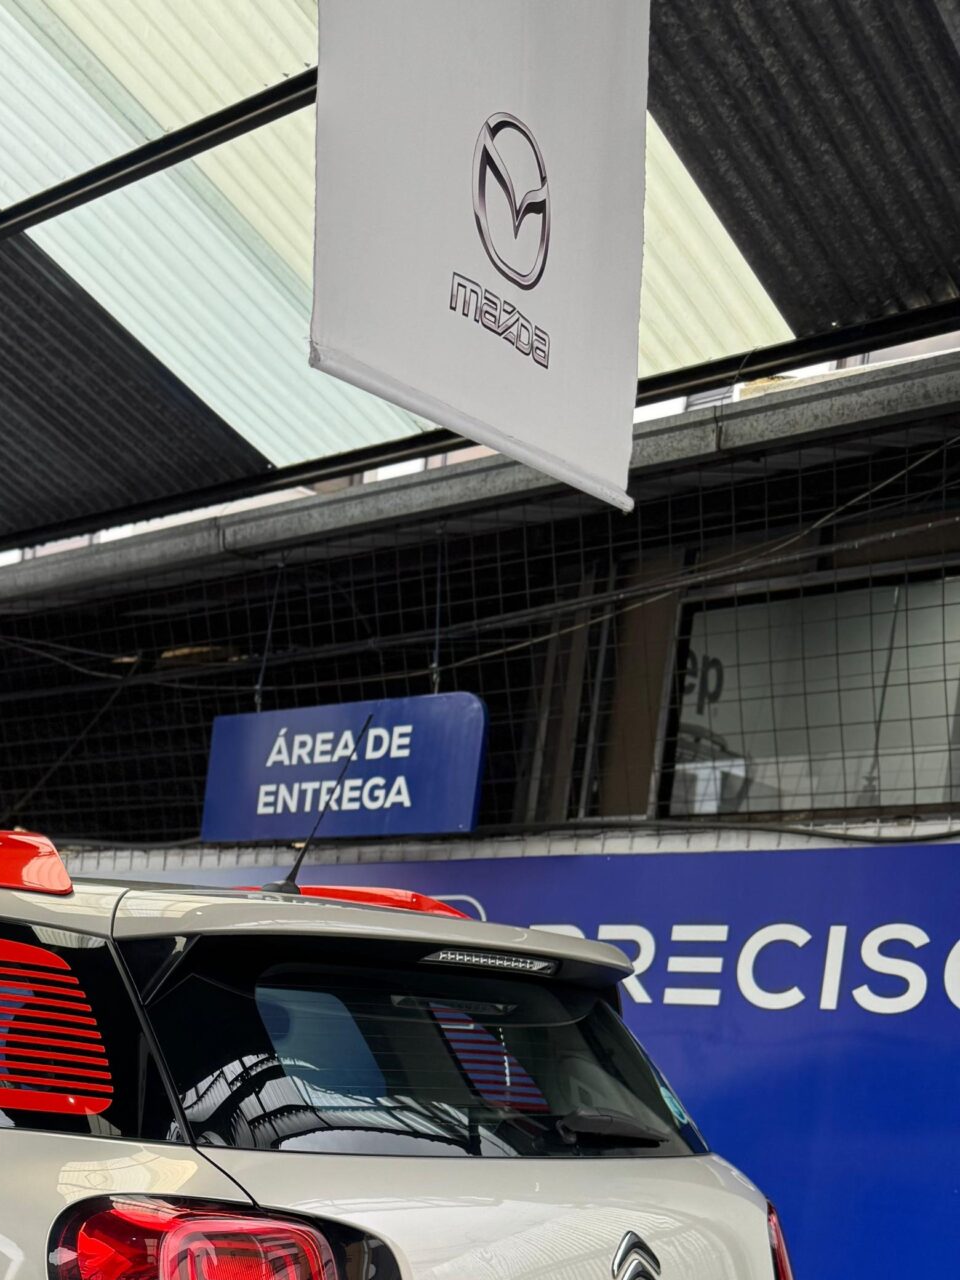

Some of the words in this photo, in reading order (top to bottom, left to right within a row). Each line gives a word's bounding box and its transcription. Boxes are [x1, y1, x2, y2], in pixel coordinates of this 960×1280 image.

[265, 727, 358, 768] ÁREA
[364, 724, 413, 760] DE
[256, 775, 412, 815] ENTREGA
[529, 922, 960, 1015] RECIS
